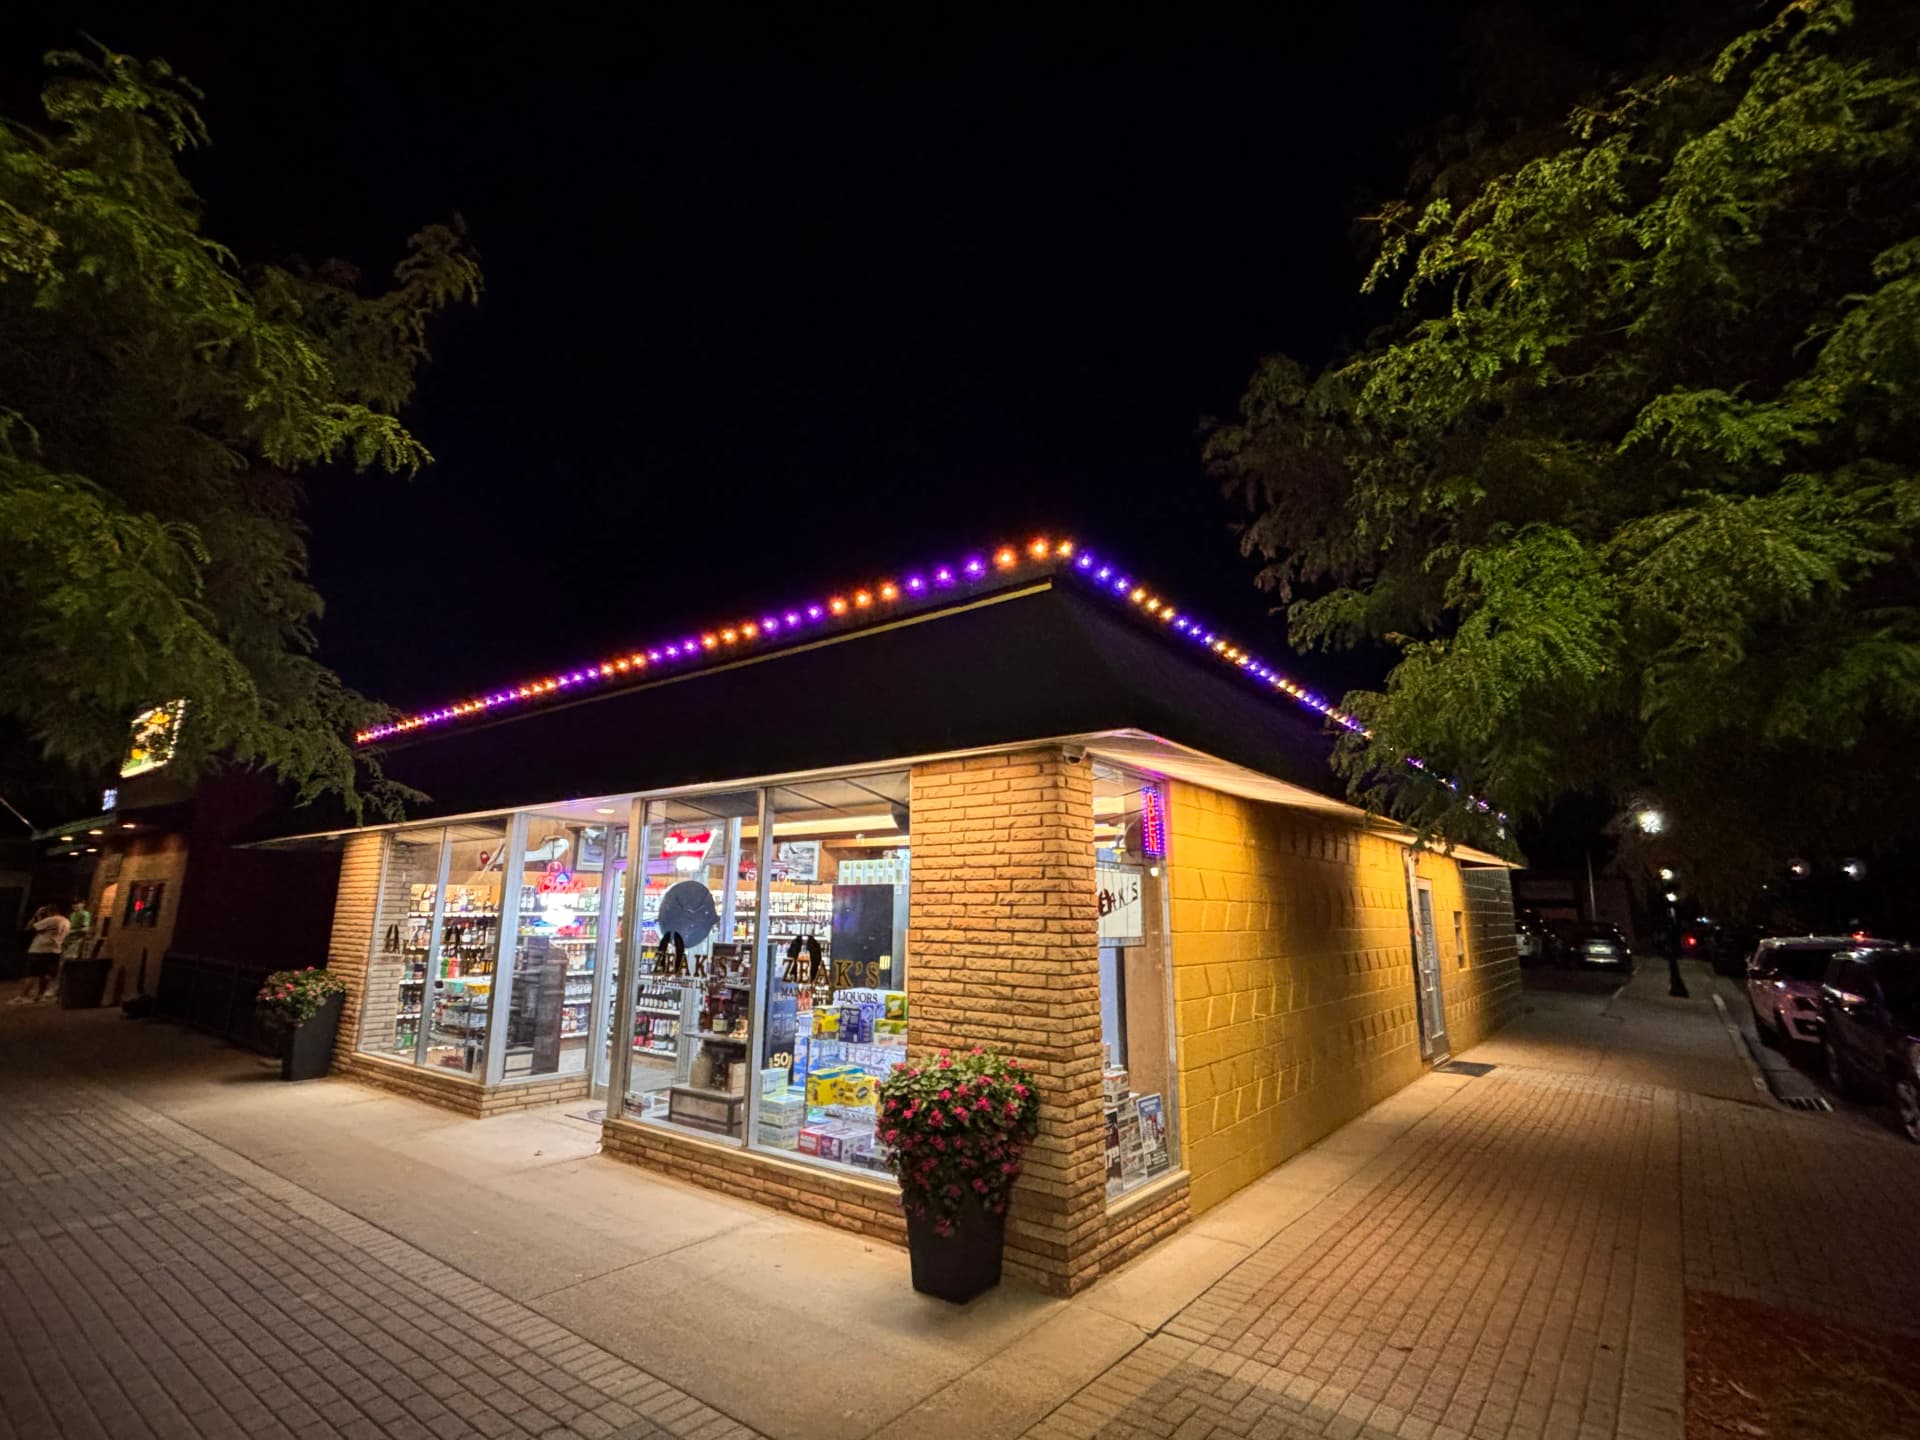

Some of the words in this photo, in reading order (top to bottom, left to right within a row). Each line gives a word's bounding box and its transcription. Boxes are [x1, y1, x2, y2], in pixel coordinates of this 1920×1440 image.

[1147, 793, 1157, 852] OPEN
[782, 957, 881, 990] ZEAK'S
[838, 990, 878, 1004] LIQUORS
